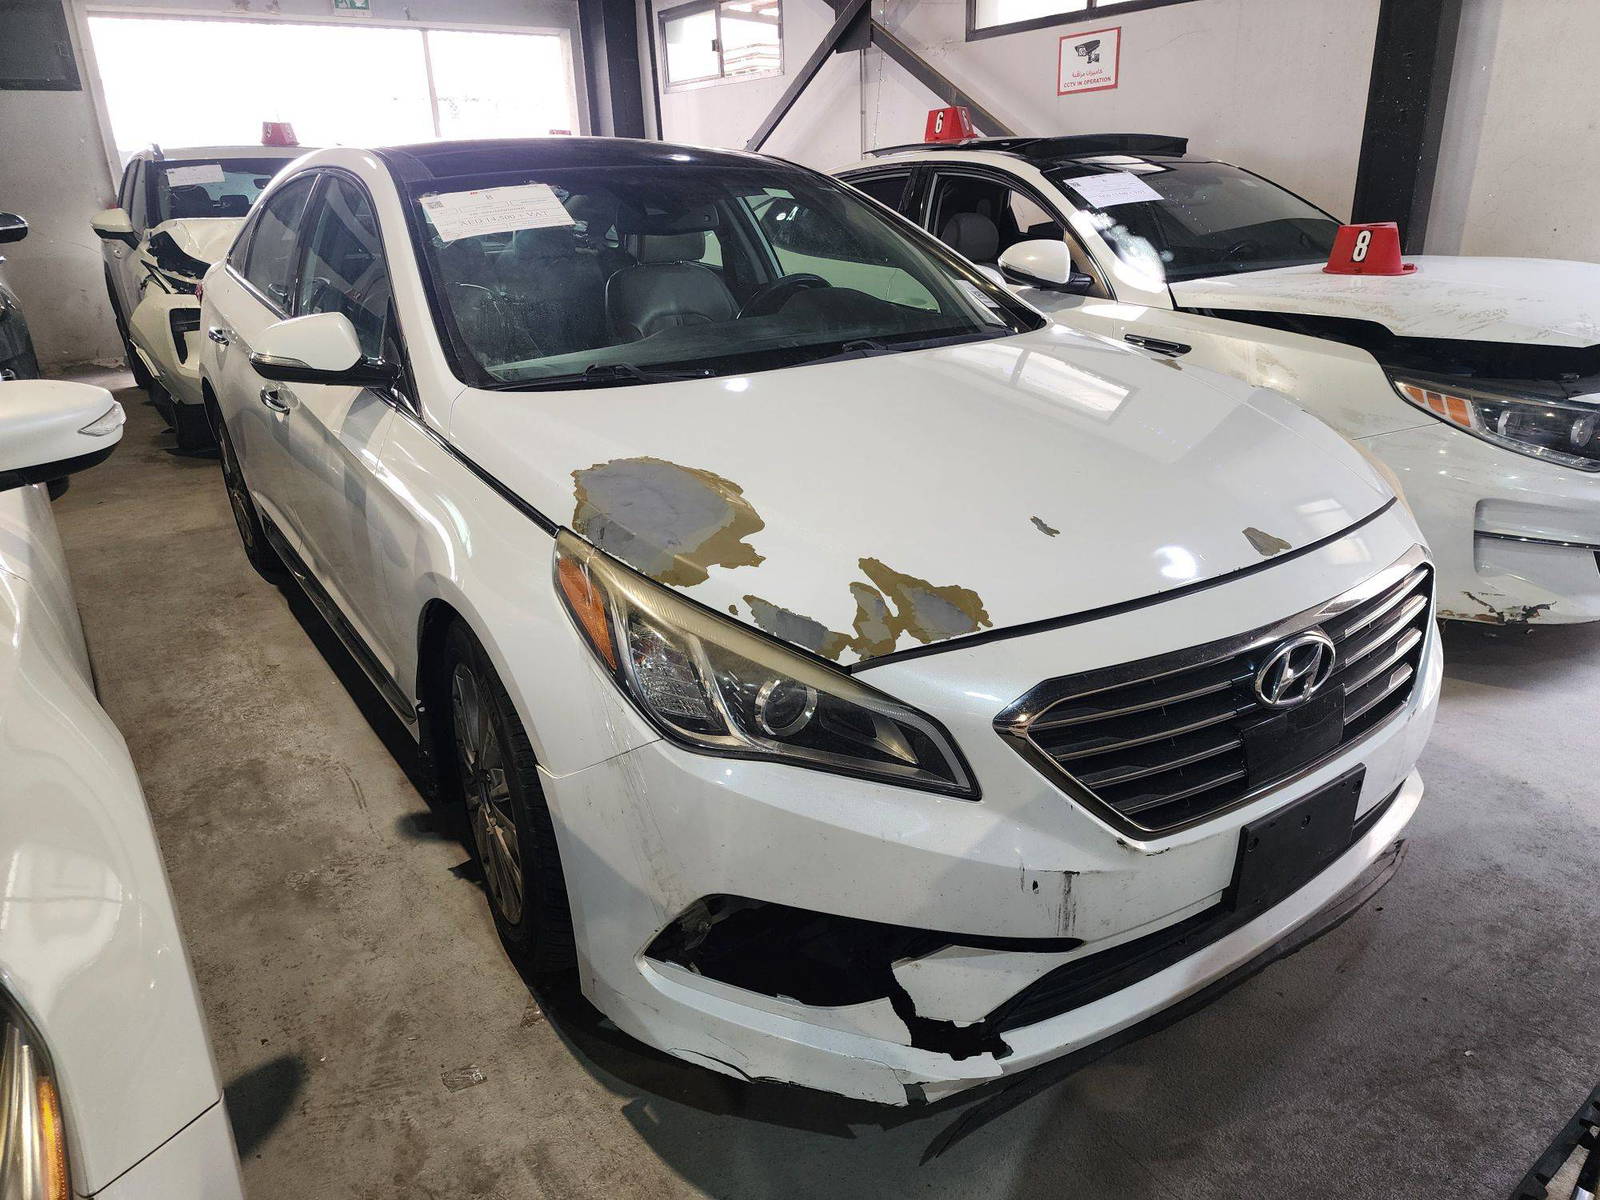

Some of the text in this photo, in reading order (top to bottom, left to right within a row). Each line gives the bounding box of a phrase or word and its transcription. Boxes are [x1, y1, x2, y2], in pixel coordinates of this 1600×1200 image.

[1064, 80, 1076, 88] CCTV
[1083, 75, 1111, 85] OPERATION
[935, 111, 944, 134] 6
[1352, 230, 1371, 262] 8
